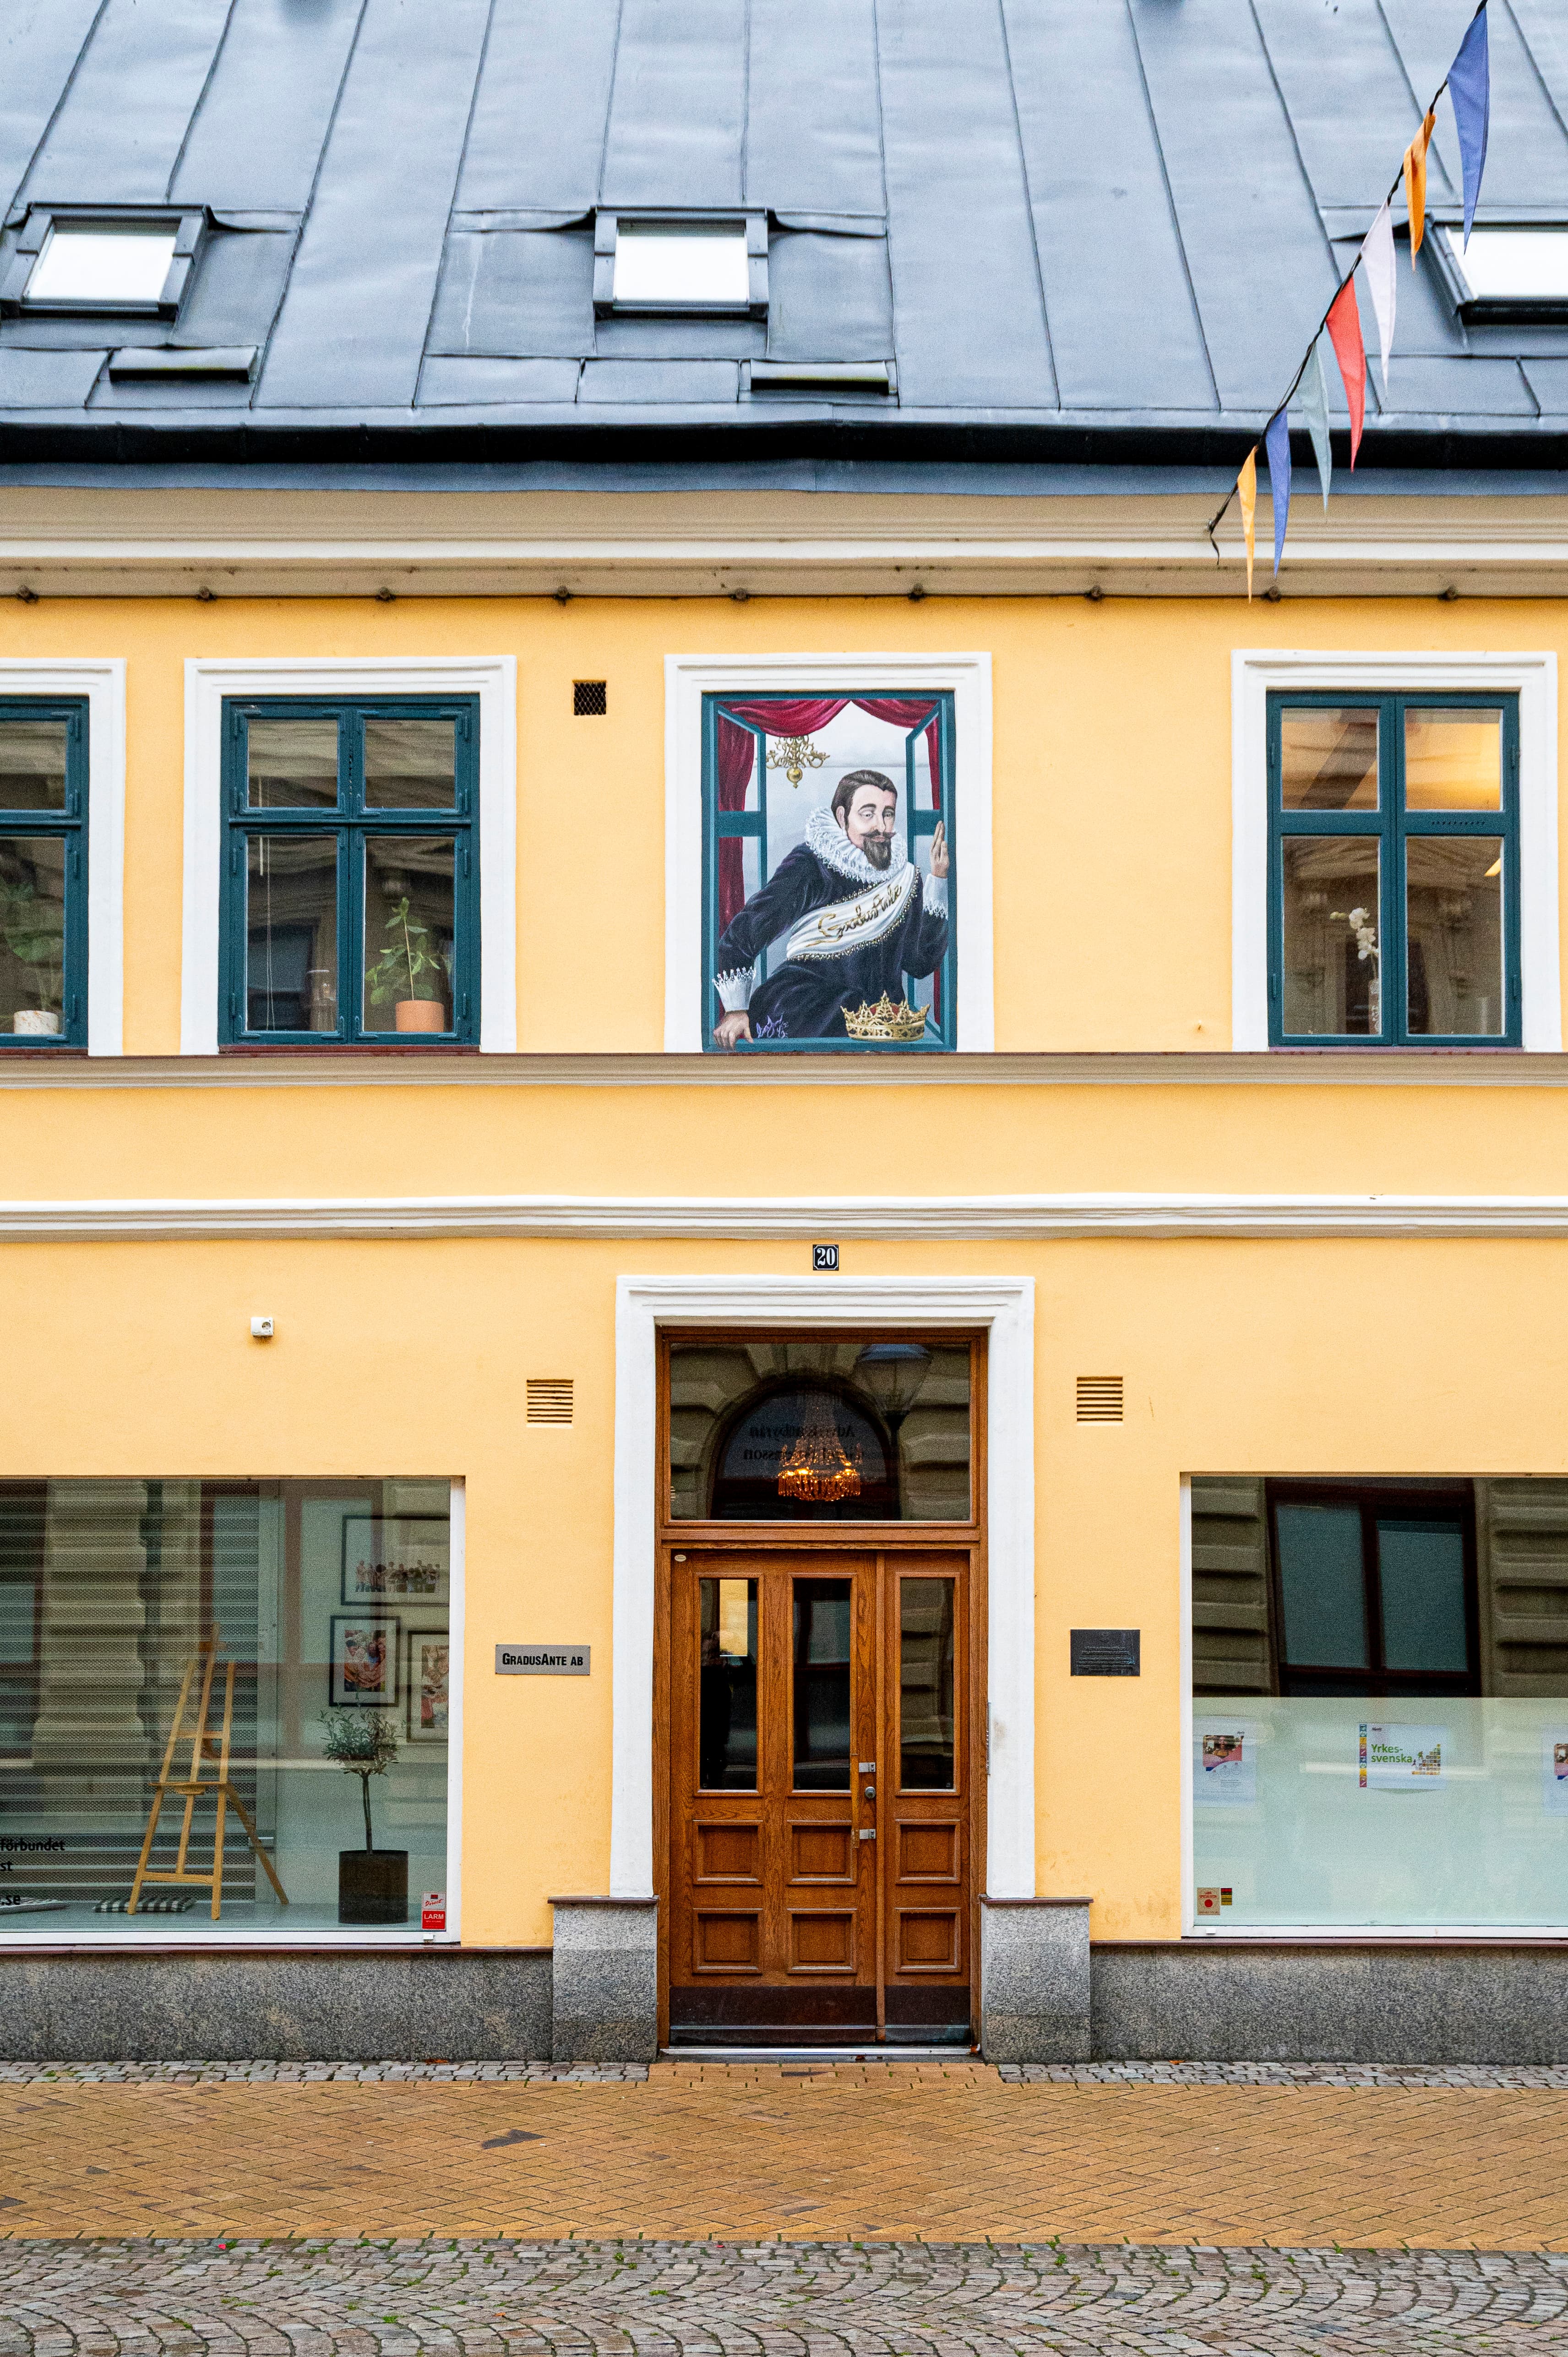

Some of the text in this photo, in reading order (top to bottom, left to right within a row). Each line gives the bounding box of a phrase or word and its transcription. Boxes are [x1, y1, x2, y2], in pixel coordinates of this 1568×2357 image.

[817, 1248, 835, 1266] 20
[570, 1656, 583, 1666] AB
[1371, 1743, 1403, 1753] Yrkes-
[1371, 1754, 1413, 1763] svenska
